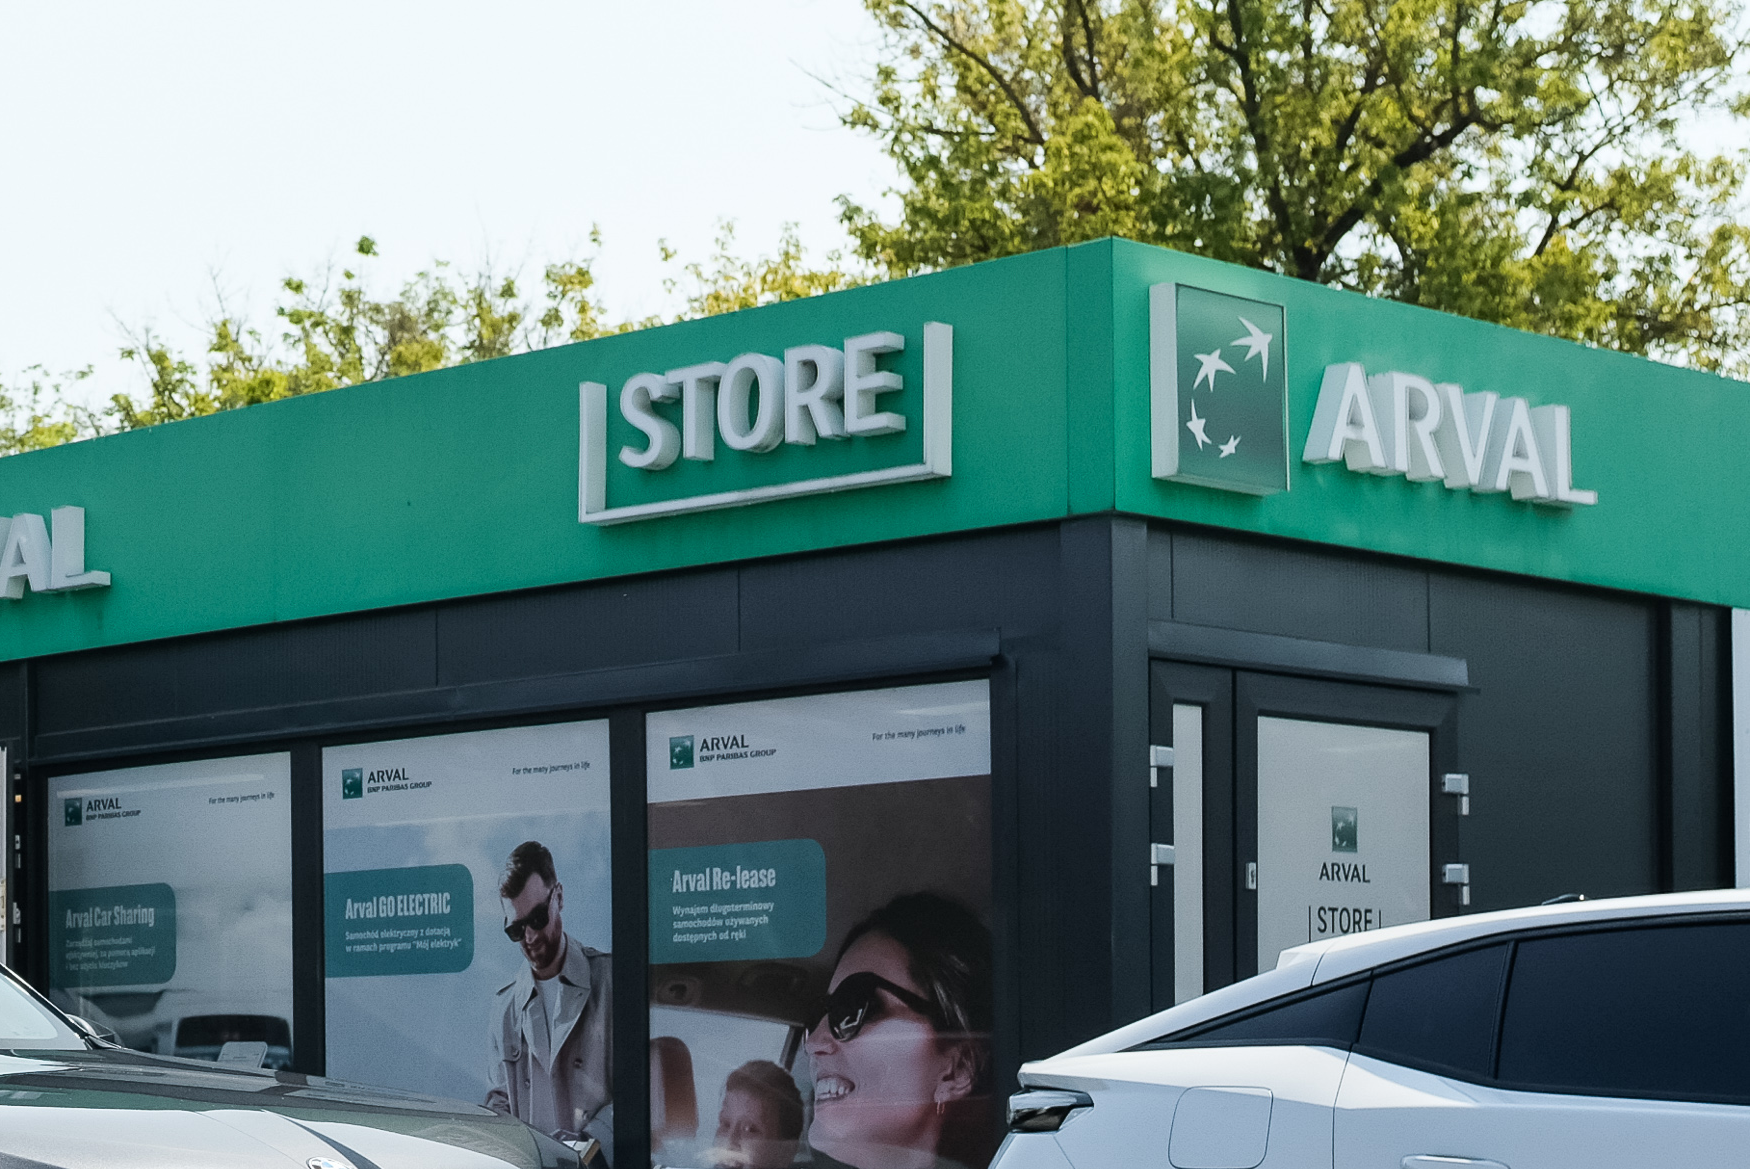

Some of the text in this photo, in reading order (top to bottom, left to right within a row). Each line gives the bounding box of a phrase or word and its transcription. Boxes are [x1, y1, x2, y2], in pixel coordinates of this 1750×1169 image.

[619, 330, 906, 471] STORE
[1303, 361, 1598, 506] ARVAL
[700, 734, 749, 752] ARVAL
[750, 749, 777, 758] GROUP
[367, 767, 409, 784] ARVAL
[86, 797, 122, 812] ARVAL
[672, 865, 776, 893] Arval Re-lease
[1319, 862, 1371, 883] ARVAL
[66, 904, 155, 929] Arval Car Sharing
[345, 892, 451, 920] Arval GO ELECTRIC
[1317, 905, 1372, 934] STORE
